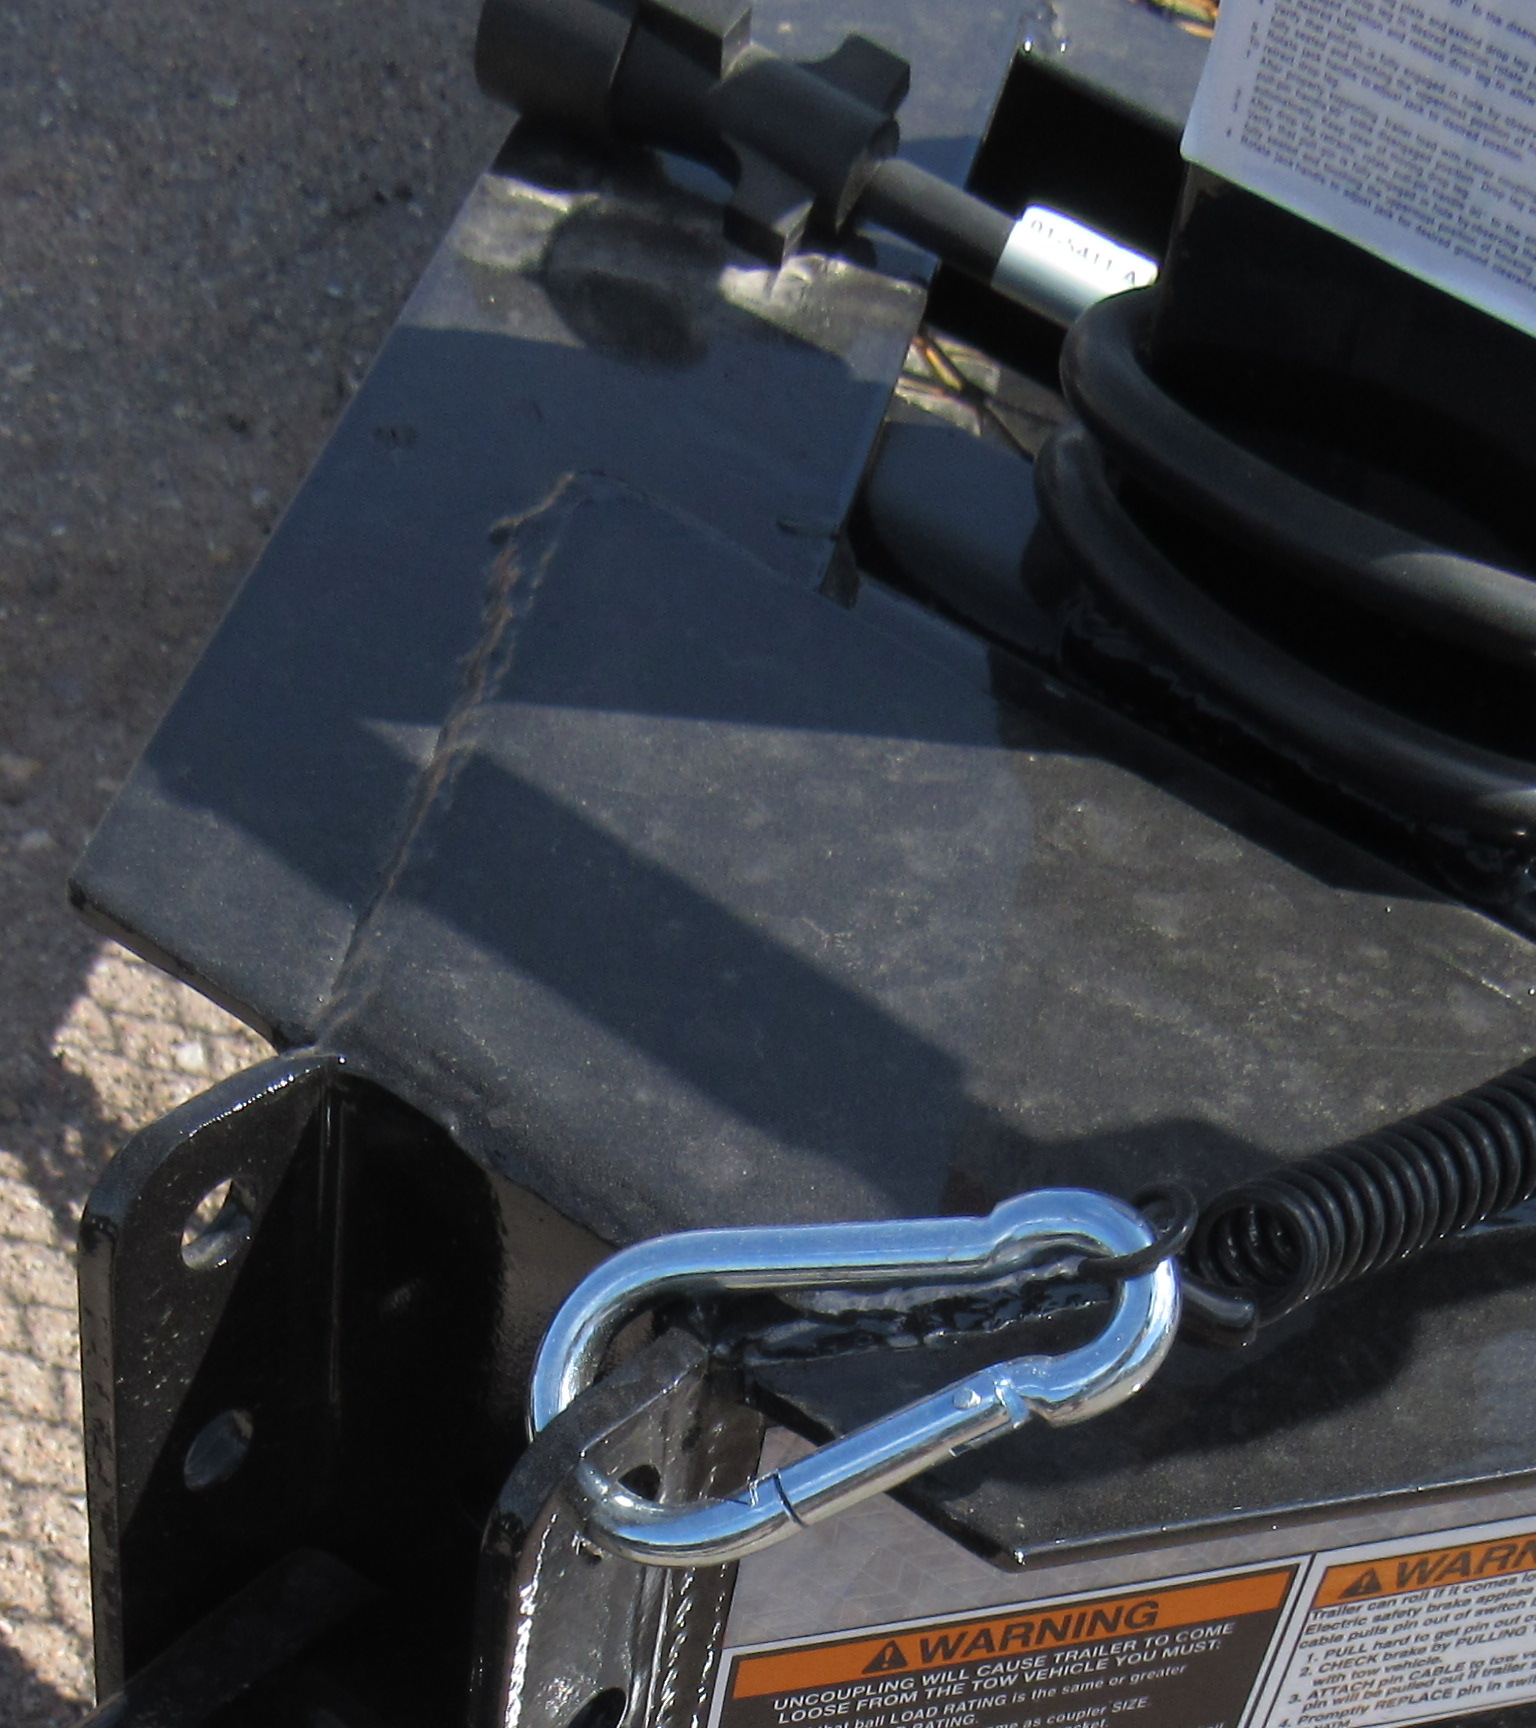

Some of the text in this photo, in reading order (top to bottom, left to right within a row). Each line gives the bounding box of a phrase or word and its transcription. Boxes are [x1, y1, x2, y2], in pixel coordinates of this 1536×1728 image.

[1304, 1616, 1367, 1635] Electric
[1372, 1607, 1422, 1623] safety
[1425, 1597, 1472, 1613] brake
[1475, 1586, 1534, 1604] applies
[1312, 1604, 1362, 1620] Trailer
[1366, 1598, 1397, 1611] can
[1400, 1589, 1430, 1605] roll
[1432, 1586, 1446, 1598] if
[1447, 1584, 1460, 1596] it
[1462, 1576, 1517, 1594] comes
[920, 1602, 1161, 1662] WARNING
[1298, 1633, 1344, 1649] cable
[1347, 1625, 1388, 1641] pulls
[1390, 1619, 1419, 1634] pin
[1422, 1612, 1450, 1627] out
[1453, 1608, 1472, 1621] of
[1474, 1599, 1526, 1617] switch
[1323, 1643, 1367, 1659] PULL
[1372, 1634, 1411, 1650] hard
[1413, 1632, 1430, 1643] to
[1433, 1626, 1461, 1641] get
[1462, 1621, 1490, 1636] pin
[1493, 1614, 1521, 1628] out
[774, 1623, 1234, 1710] UNCOUPLING WILL CAUSE TRAILER TO COME
[1312, 1655, 1442, 1686] with tow vehicle.
[1318, 1653, 1378, 1673] CHECK
[1382, 1646, 1427, 1661] brake
[1430, 1641, 1451, 1652] by
[1455, 1625, 1527, 1647] PULLING
[778, 1639, 1219, 1724] LOOSE FROM THE TOW VEHICLE YOU MUST:
[889, 1705, 938, 1724] LOAD
[942, 1694, 1006, 1715] RATING
[1011, 1692, 1026, 1703] is
[1030, 1687, 1057, 1700] the
[1061, 1679, 1104, 1694] same
[1108, 1675, 1125, 1686] or
[1129, 1665, 1185, 1682] greater
[1307, 1679, 1375, 1700] ATTACH
[1377, 1674, 1404, 1688] pin
[1408, 1661, 1466, 1681] CABLE
[1468, 1659, 1485, 1670] to
[1488, 1654, 1518, 1666] tow
[1022, 1717, 1041, 1728] as
[1046, 1706, 1106, 1724] coupler
[1296, 1705, 1369, 1725] Promptly
[1374, 1687, 1453, 1709] REPLACE
[1456, 1684, 1482, 1698] pin
[1486, 1681, 1502, 1692] in
